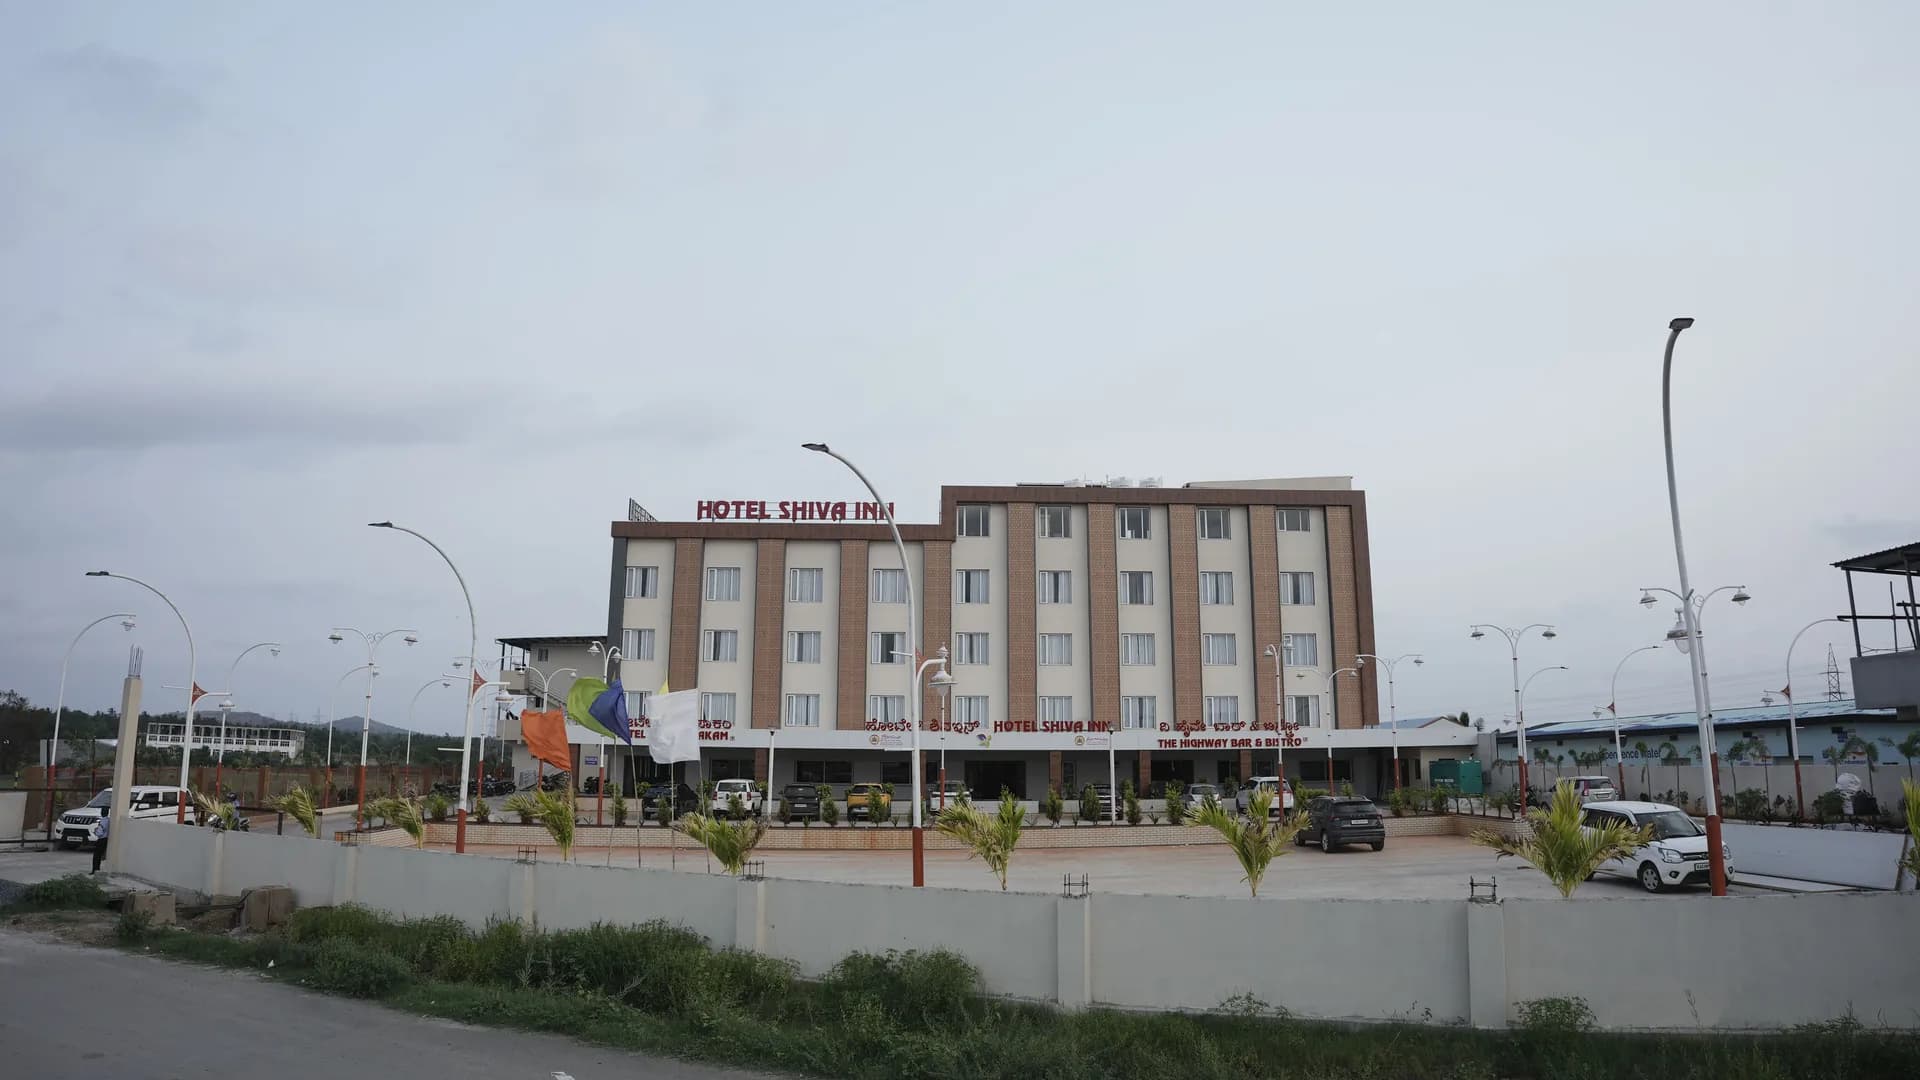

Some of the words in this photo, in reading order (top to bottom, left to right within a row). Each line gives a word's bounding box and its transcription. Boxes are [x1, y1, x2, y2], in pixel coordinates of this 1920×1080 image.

[697, 500, 771, 520] HOTEL
[779, 501, 847, 522] SHIVA
[855, 501, 895, 520] INN
[993, 720, 1038, 733] HOTEL
[1042, 720, 1084, 734] SHIVA
[1087, 720, 1111, 732] INN
[629, 729, 646, 738] TEL
[1157, 738, 1177, 748] THE
[1180, 738, 1228, 748] HIGHWAY
[1231, 738, 1252, 747] BAR
[1255, 738, 1262, 747] &
[1266, 737, 1302, 747] BISTRO
